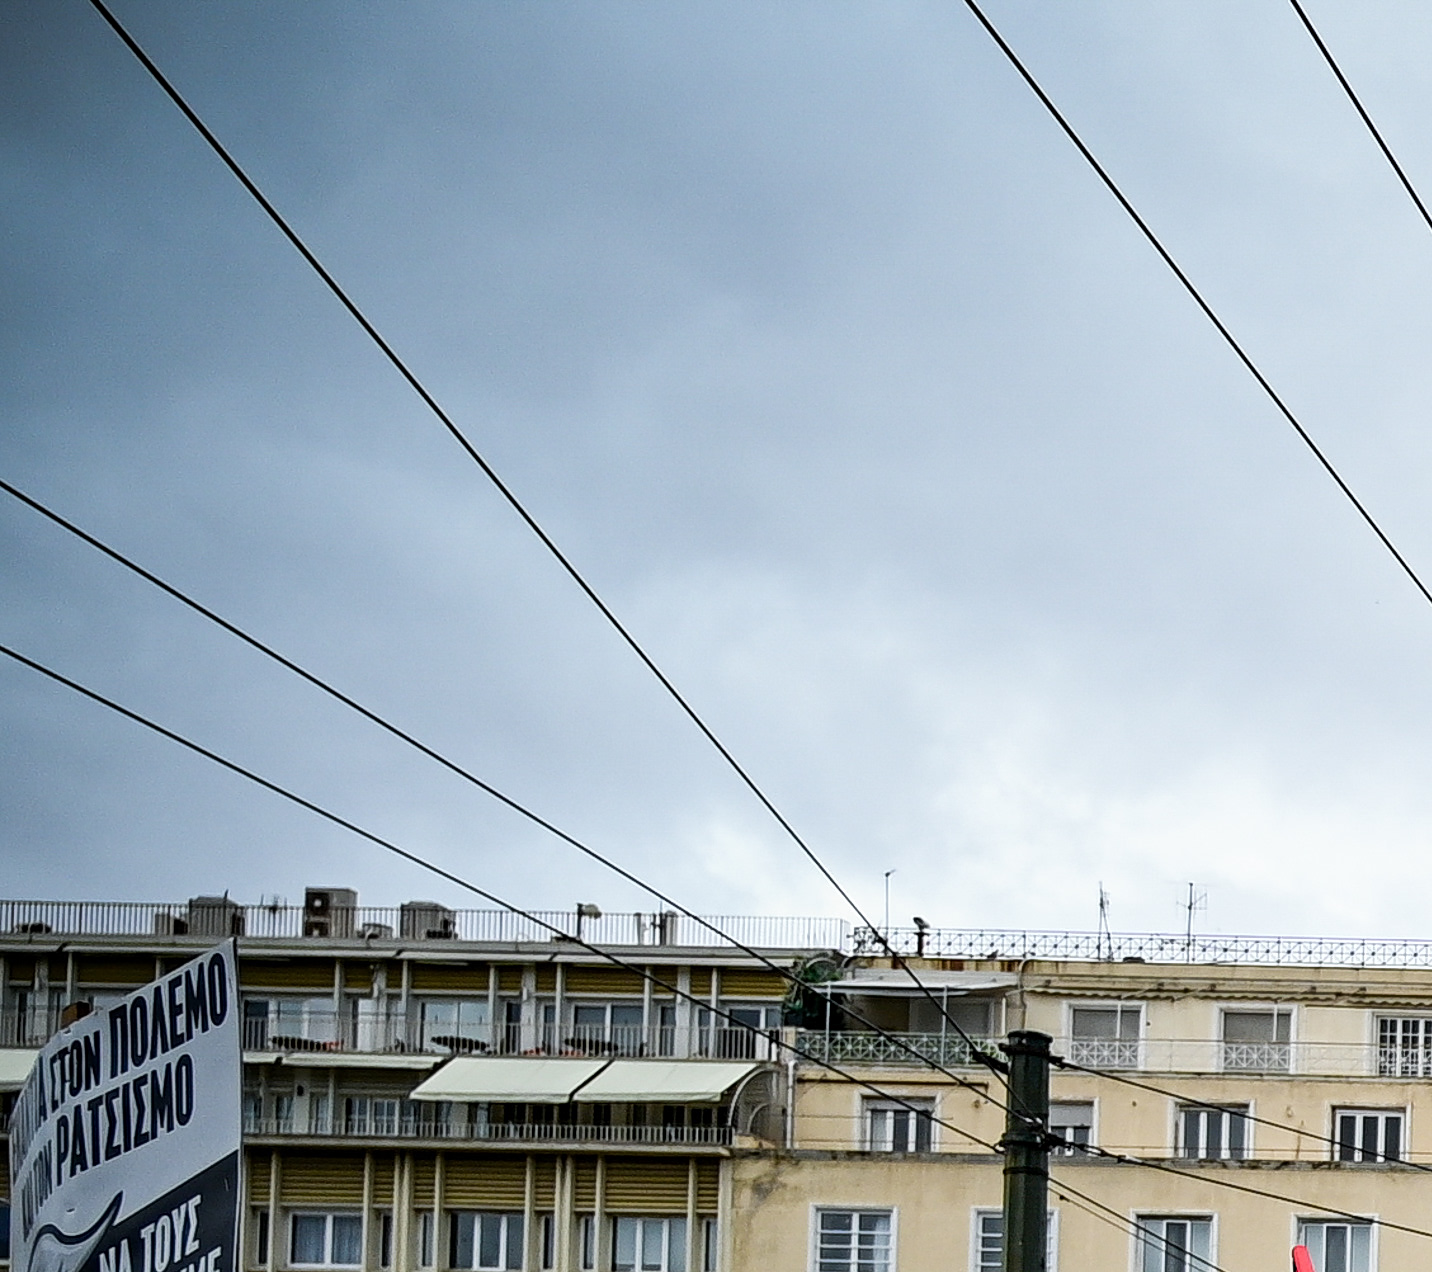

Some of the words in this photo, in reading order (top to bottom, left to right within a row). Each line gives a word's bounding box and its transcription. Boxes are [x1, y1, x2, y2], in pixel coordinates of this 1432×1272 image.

[50, 1029, 101, 1113] ΣΤΟΝ
[109, 952, 228, 1079] ΠΟΛΕΜΟ
[56, 1054, 194, 1187] ΡΑΤΣΙΣΜΟ
